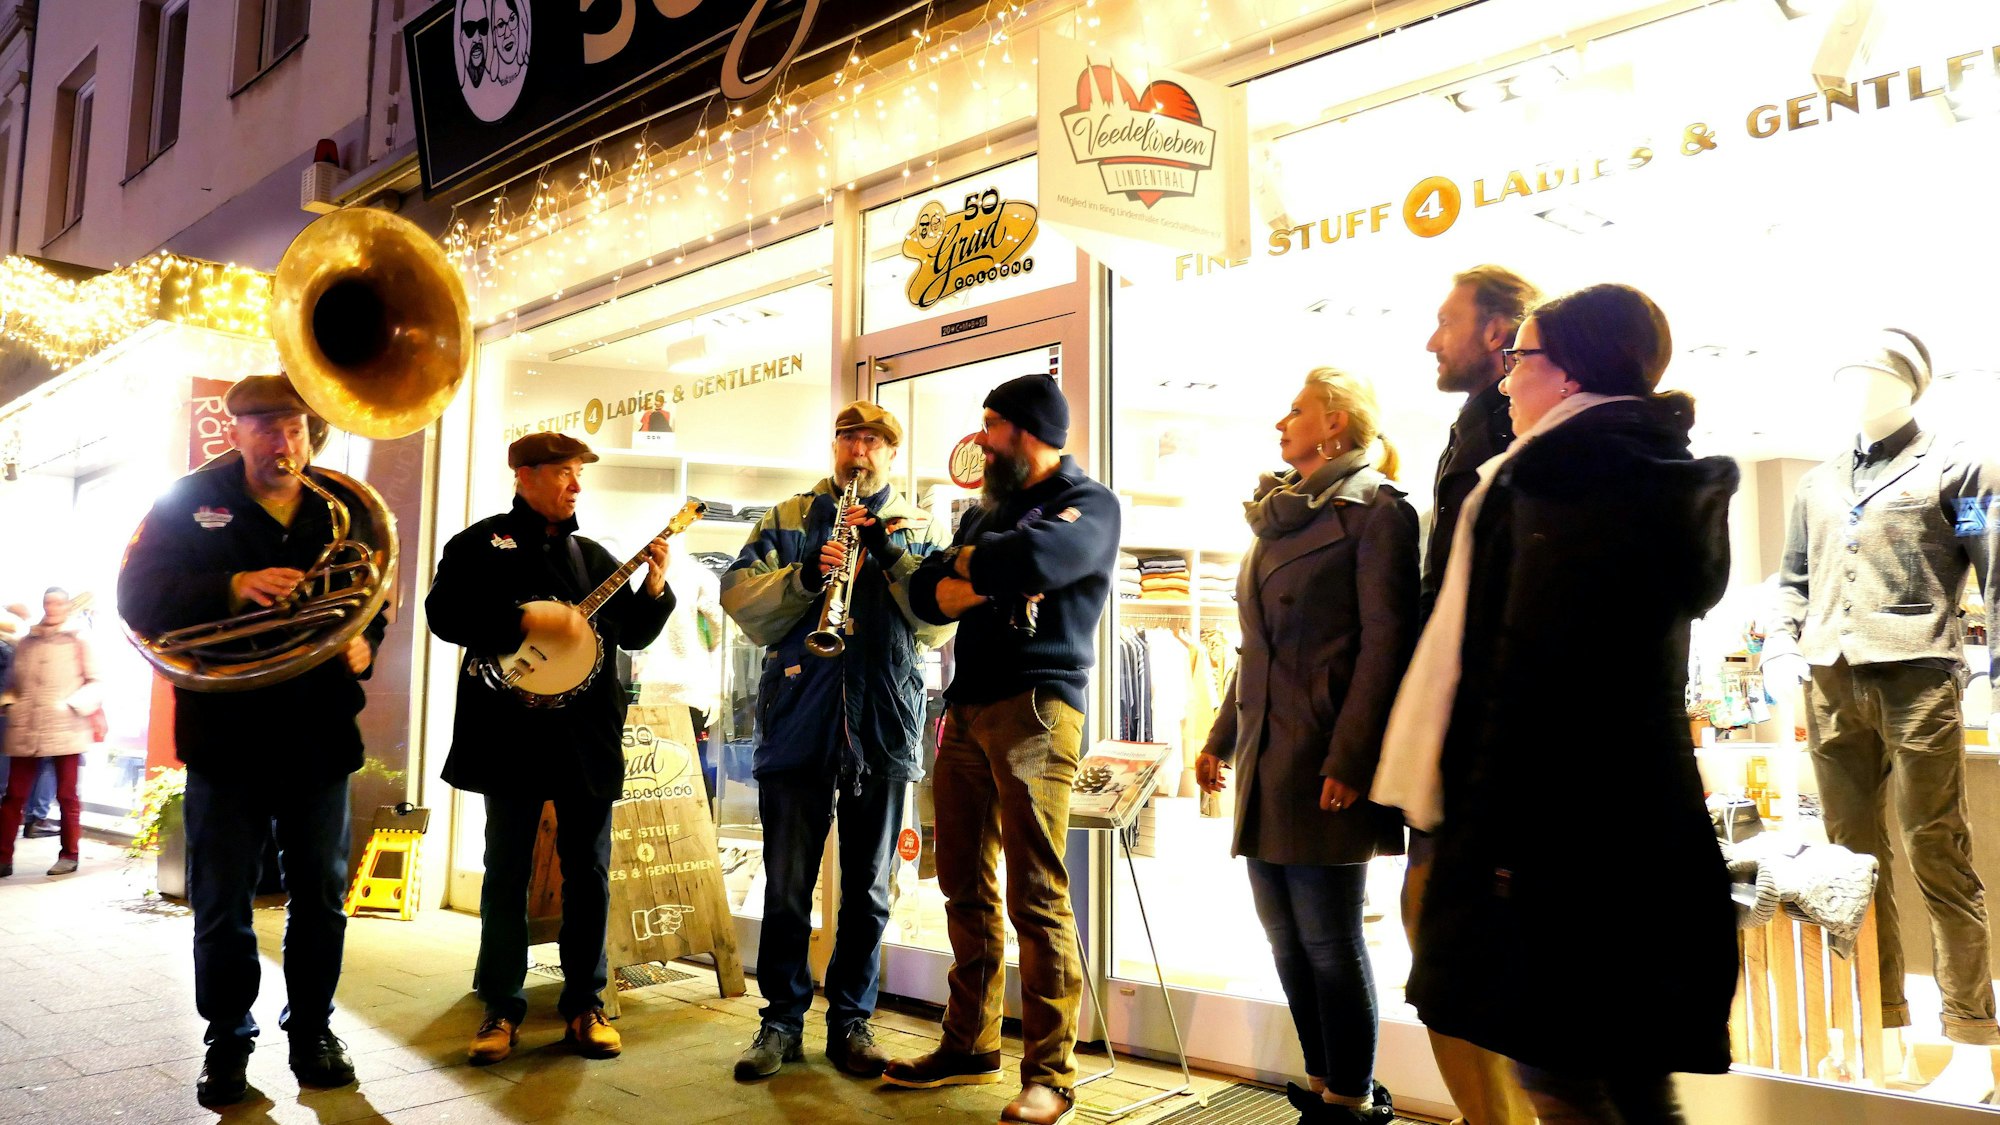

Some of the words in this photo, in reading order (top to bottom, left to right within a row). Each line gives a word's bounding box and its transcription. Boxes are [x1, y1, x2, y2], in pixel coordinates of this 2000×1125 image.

[1268, 203, 1391, 257] STUFF
[1680, 122, 1718, 156] &
[1746, 45, 2000, 139] GENTLE
[1115, 169, 1185, 189] LINDENTHAL
[963, 187, 1000, 221] 50
[1056, 194, 1087, 209] Mitglied
[1088, 203, 1098, 211] im
[1099, 205, 1116, 217] Ring
[918, 200, 1007, 308] Grad
[954, 258, 1034, 291] COLOGNE
[537, 410, 581, 432] STUFF
[672, 384, 685, 404] &
[692, 352, 804, 400] GENTLEMEN
[621, 726, 653, 748] 50
[623, 785, 693, 800] COLOGNE
[637, 824, 681, 838] STUFF
[631, 867, 641, 879] &
[645, 859, 715, 877] GENTLEMEN
